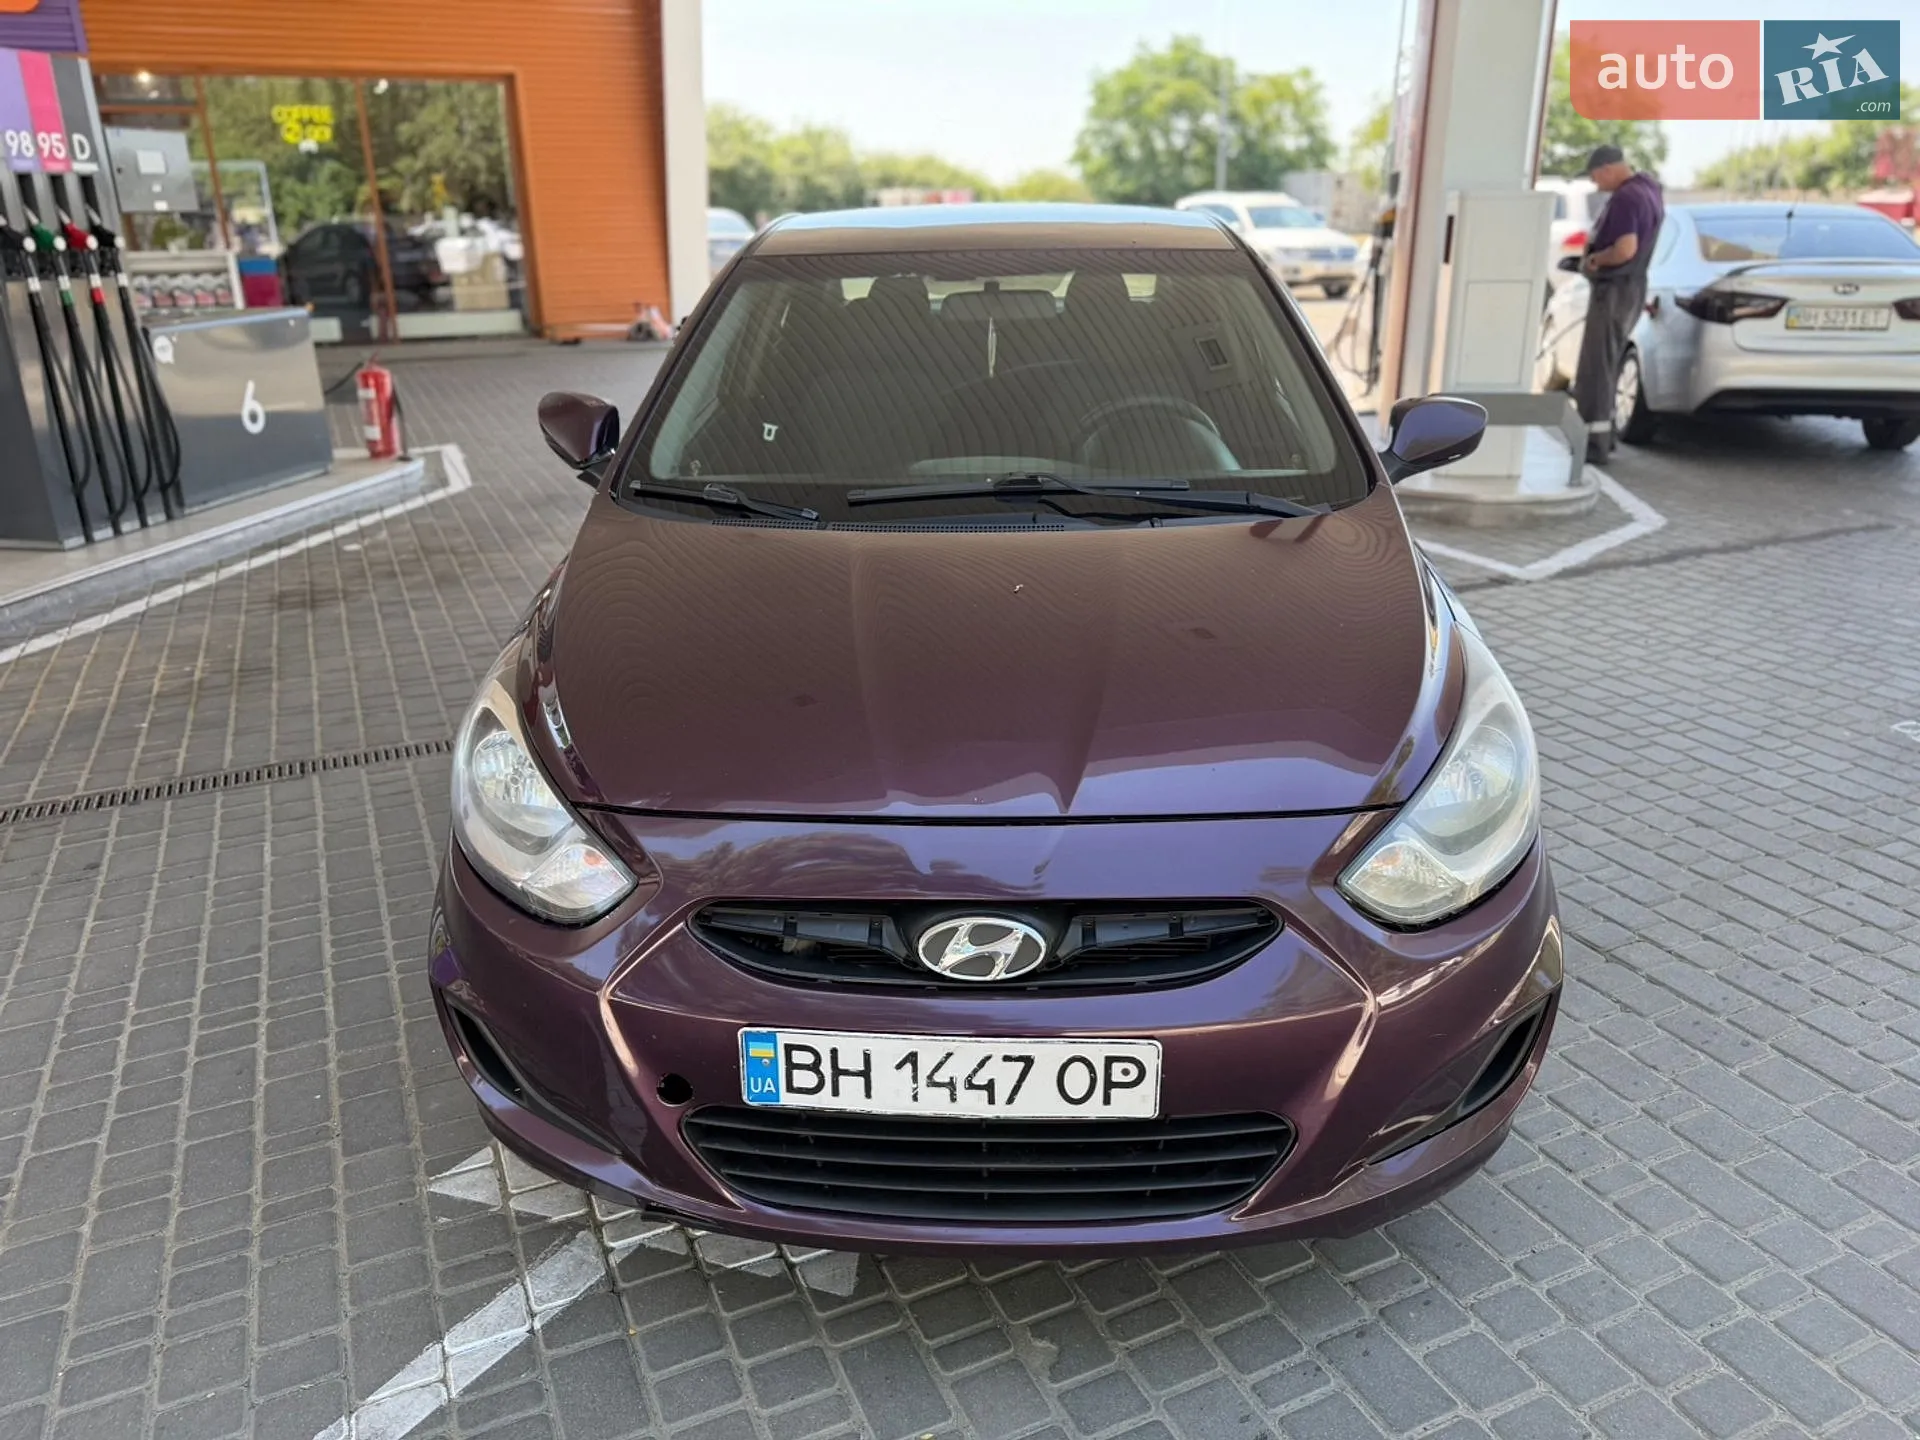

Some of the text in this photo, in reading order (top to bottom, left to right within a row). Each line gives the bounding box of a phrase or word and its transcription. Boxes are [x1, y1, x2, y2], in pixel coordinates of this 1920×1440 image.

[5, 129, 91, 160] 98 95 D
[241, 379, 266, 434] 6
[750, 1077, 776, 1094] UA
[783, 1043, 1147, 1106] BH 1447 OP
